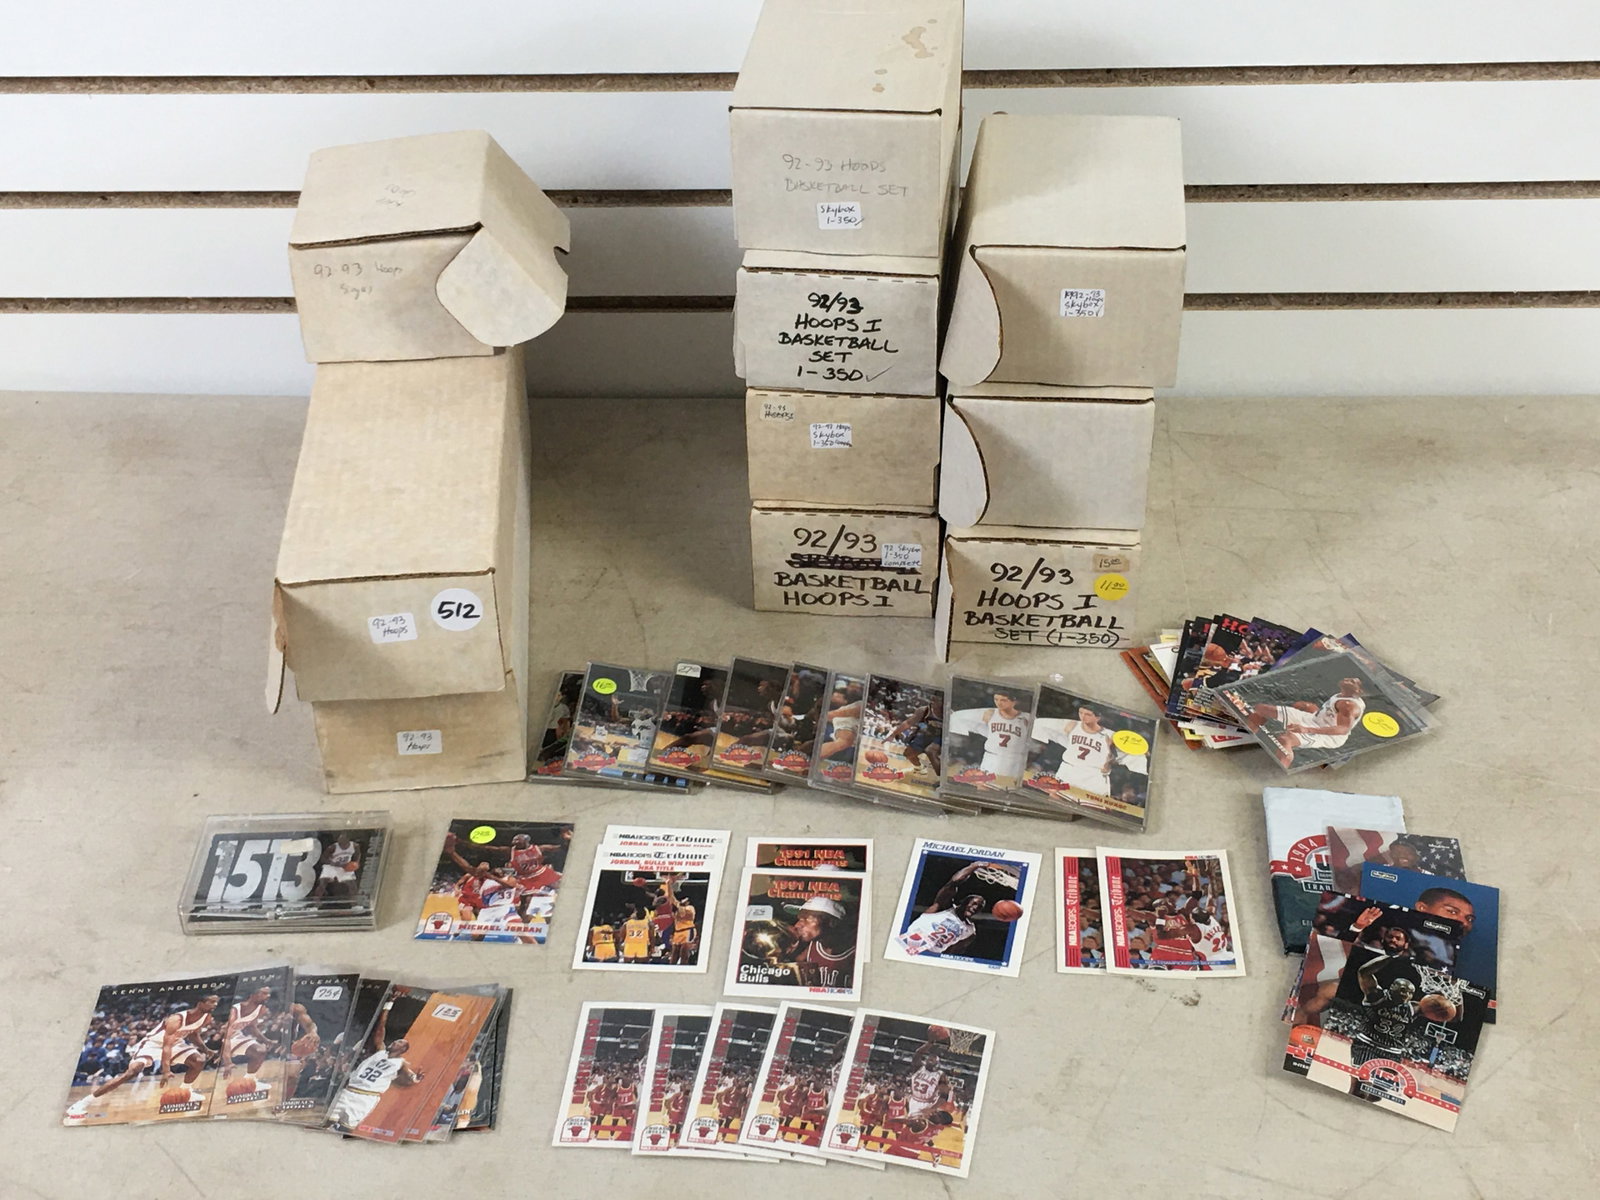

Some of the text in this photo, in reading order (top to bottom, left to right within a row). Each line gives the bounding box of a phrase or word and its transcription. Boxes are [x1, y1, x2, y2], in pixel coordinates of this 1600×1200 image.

[877, 184, 909, 197] SET
[341, 262, 363, 276] 93
[807, 291, 864, 314] 92/93
[795, 313, 883, 333] HOOPS I
[778, 331, 899, 353] BASKETBALL
[808, 351, 853, 363] SET
[793, 524, 877, 556] 92/93
[990, 557, 1074, 590] 92/93
[774, 571, 932, 594] BASKETBALL
[783, 591, 894, 607] HOOPS I
[977, 587, 1098, 610] HOOPS I
[438, 601, 480, 619] 512
[964, 611, 1124, 630] BASKETBALL
[994, 627, 1039, 641] SET
[991, 721, 1022, 737] BULLS
[999, 735, 1011, 748] 7
[1071, 734, 1102, 752] BULLS
[1077, 747, 1091, 761] 7
[662, 834, 717, 844] Tribune
[654, 851, 709, 860] Tribune
[780, 849, 846, 860] 1991 NBA
[922, 841, 1005, 858] MICHAEL JORDAN
[1290, 839, 1318, 863] 1994
[773, 879, 840, 893] 1991 NBA
[458, 924, 543, 934] MICHAEL JORDAN
[629, 930, 643, 938] 32
[740, 964, 791, 977] Chicago
[293, 978, 349, 986] COLEMAN
[739, 973, 769, 983] Bulls
[112, 981, 226, 995] KENNY ANDERSON
[359, 1067, 383, 1083] 32
[913, 1081, 930, 1095] 23
